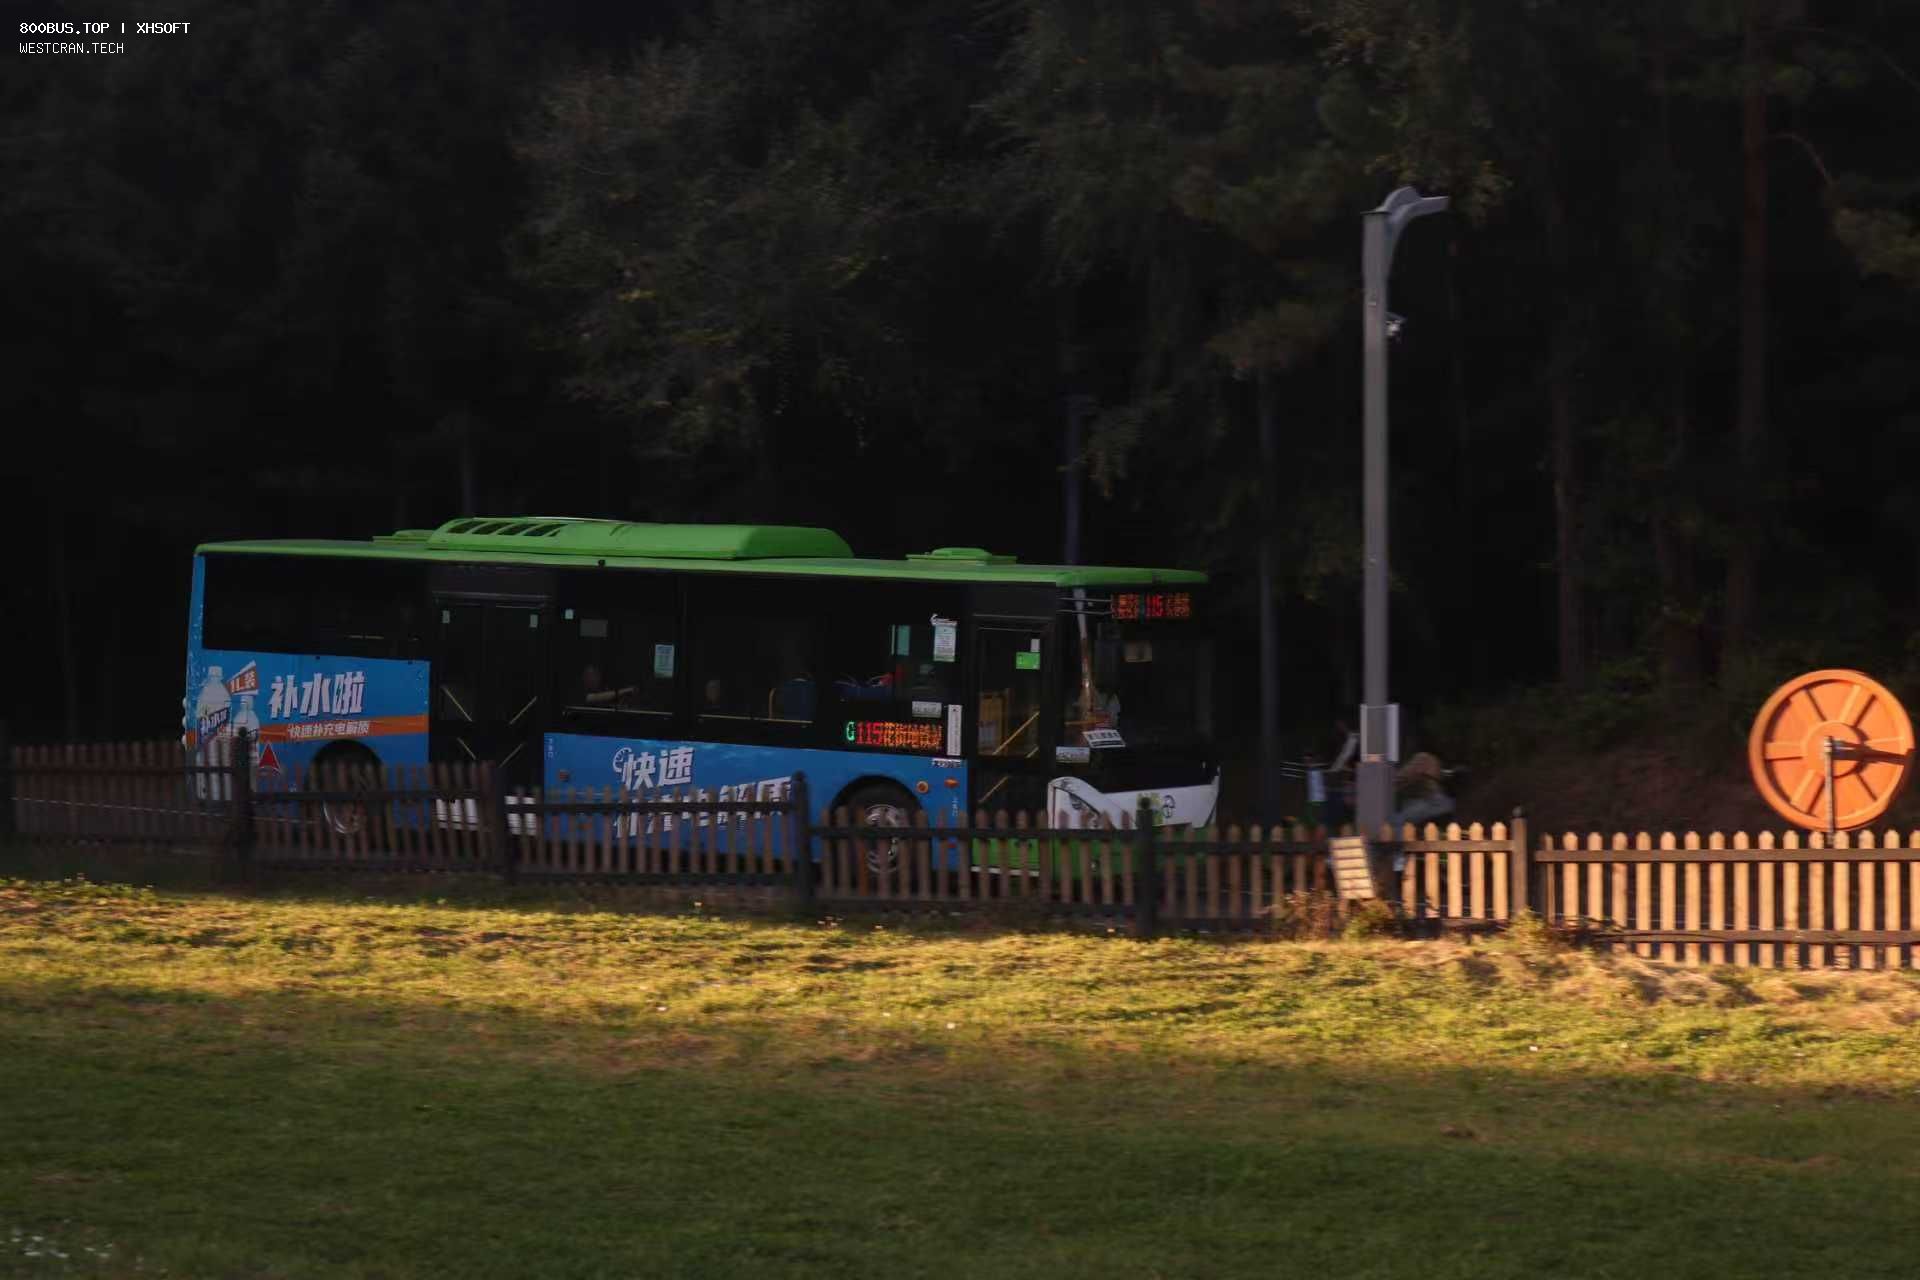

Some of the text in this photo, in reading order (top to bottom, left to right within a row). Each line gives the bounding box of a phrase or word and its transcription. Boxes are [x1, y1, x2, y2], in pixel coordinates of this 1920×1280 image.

[269, 671, 365, 719] 补水啦
[622, 747, 695, 791] 快速
